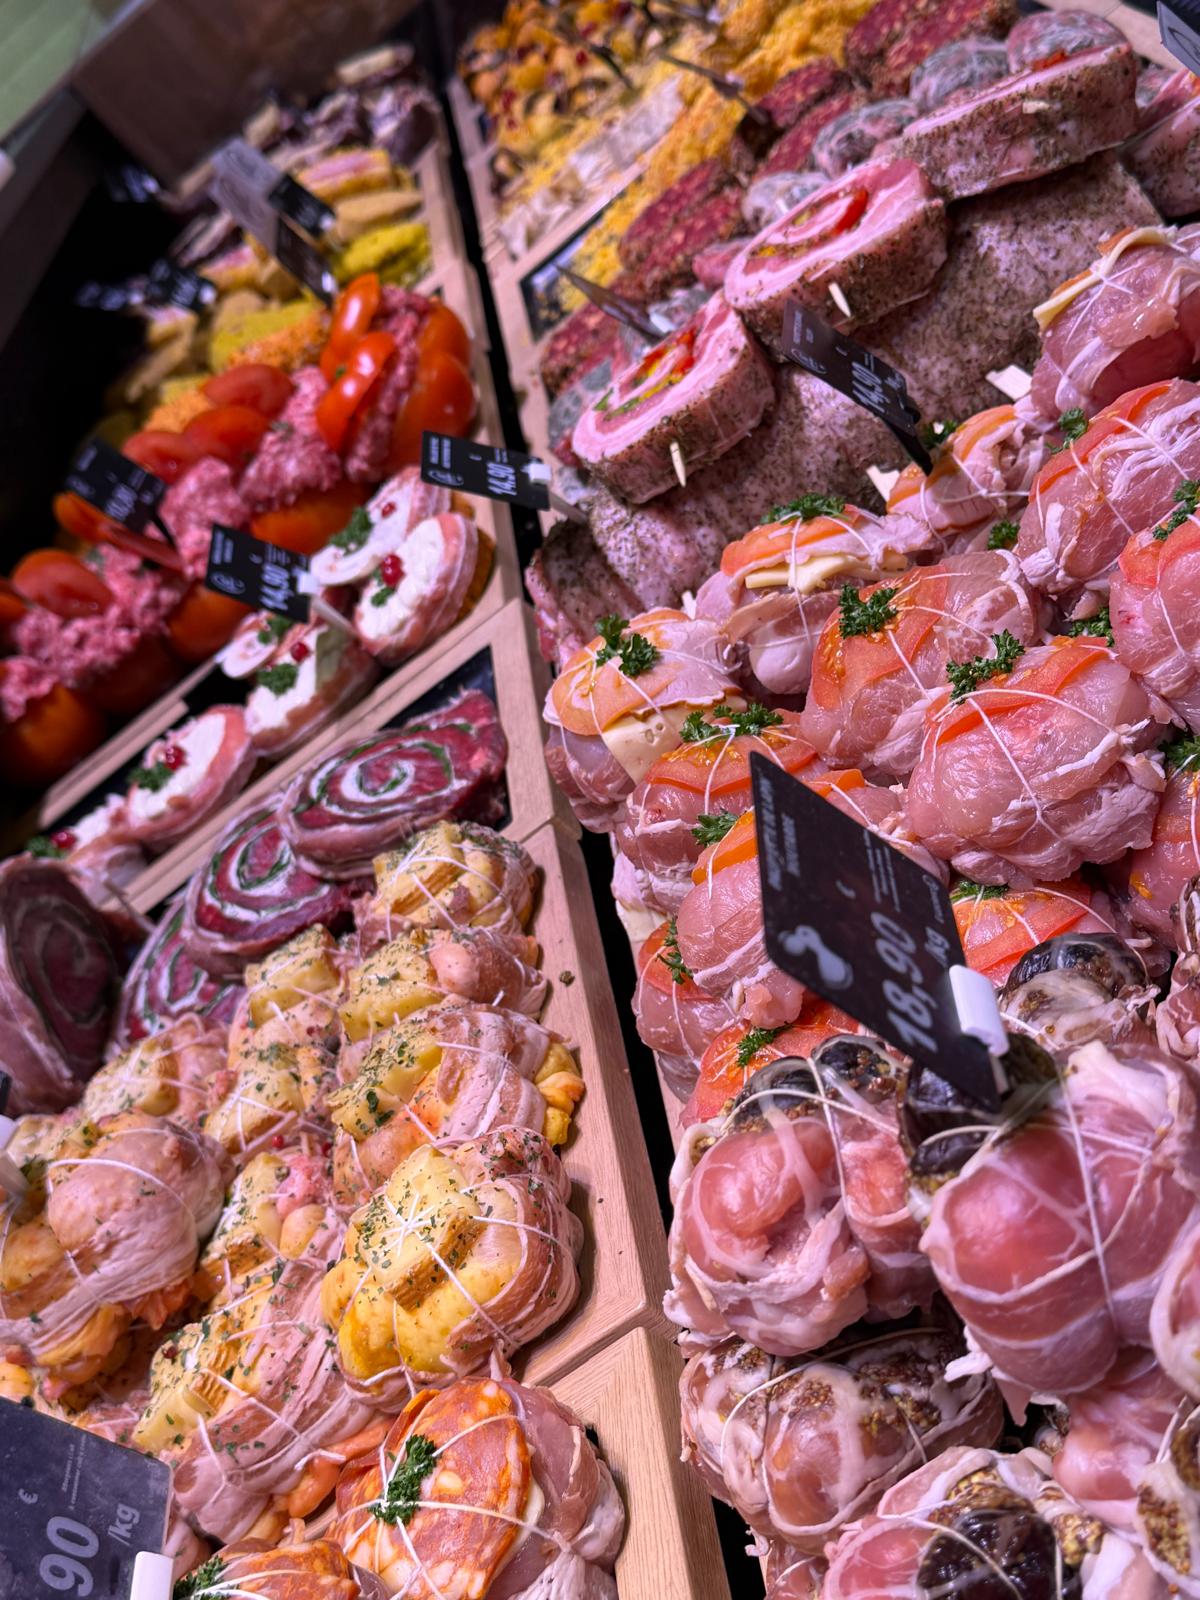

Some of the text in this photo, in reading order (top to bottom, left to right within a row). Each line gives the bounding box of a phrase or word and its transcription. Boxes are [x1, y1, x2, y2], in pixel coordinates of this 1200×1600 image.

[871, 911, 938, 1051] 18,90
[18, 1488, 38, 1504] €
[107, 1503, 139, 1546] /kg
